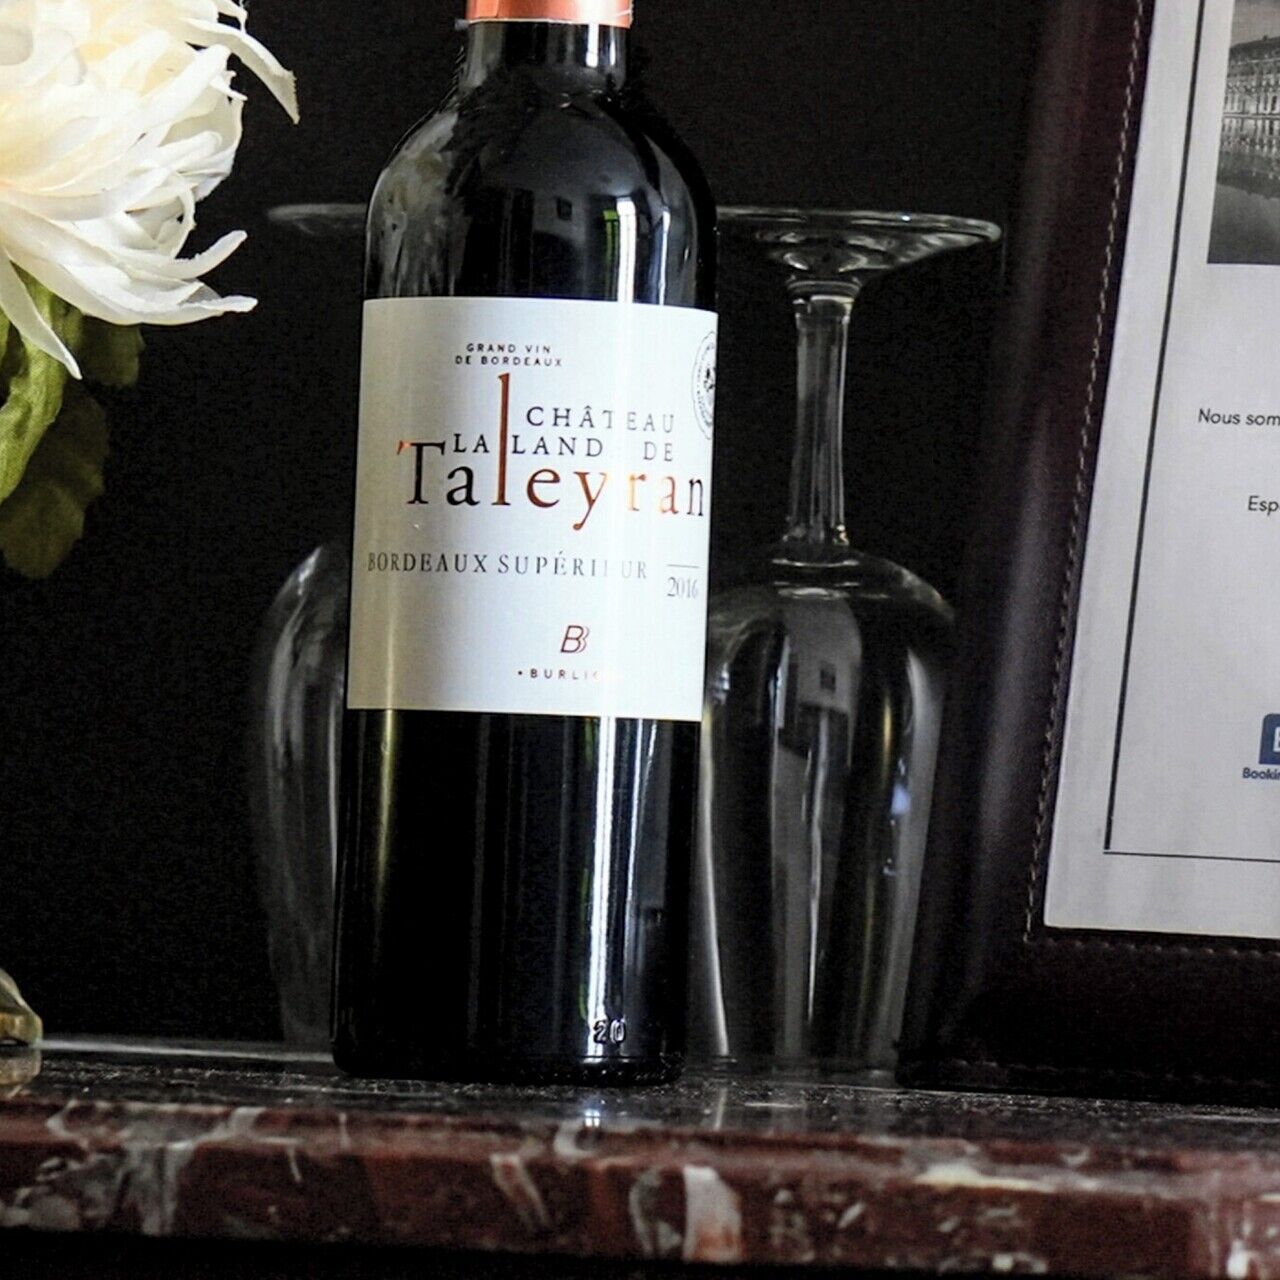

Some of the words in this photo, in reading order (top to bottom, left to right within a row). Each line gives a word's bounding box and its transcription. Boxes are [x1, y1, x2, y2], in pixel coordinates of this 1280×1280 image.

[466, 342, 517, 354] GRAND
[524, 344, 551, 354] VIN
[454, 354, 472, 366] DE
[480, 355, 563, 368] BORDEAUX
[525, 404, 676, 434] CHÂTEAU
[1197, 407, 1242, 426] Nous
[396, 372, 706, 531] Taleyran
[452, 433, 491, 455] LA
[642, 440, 675, 463] DE
[367, 551, 488, 574] BORDEAUX
